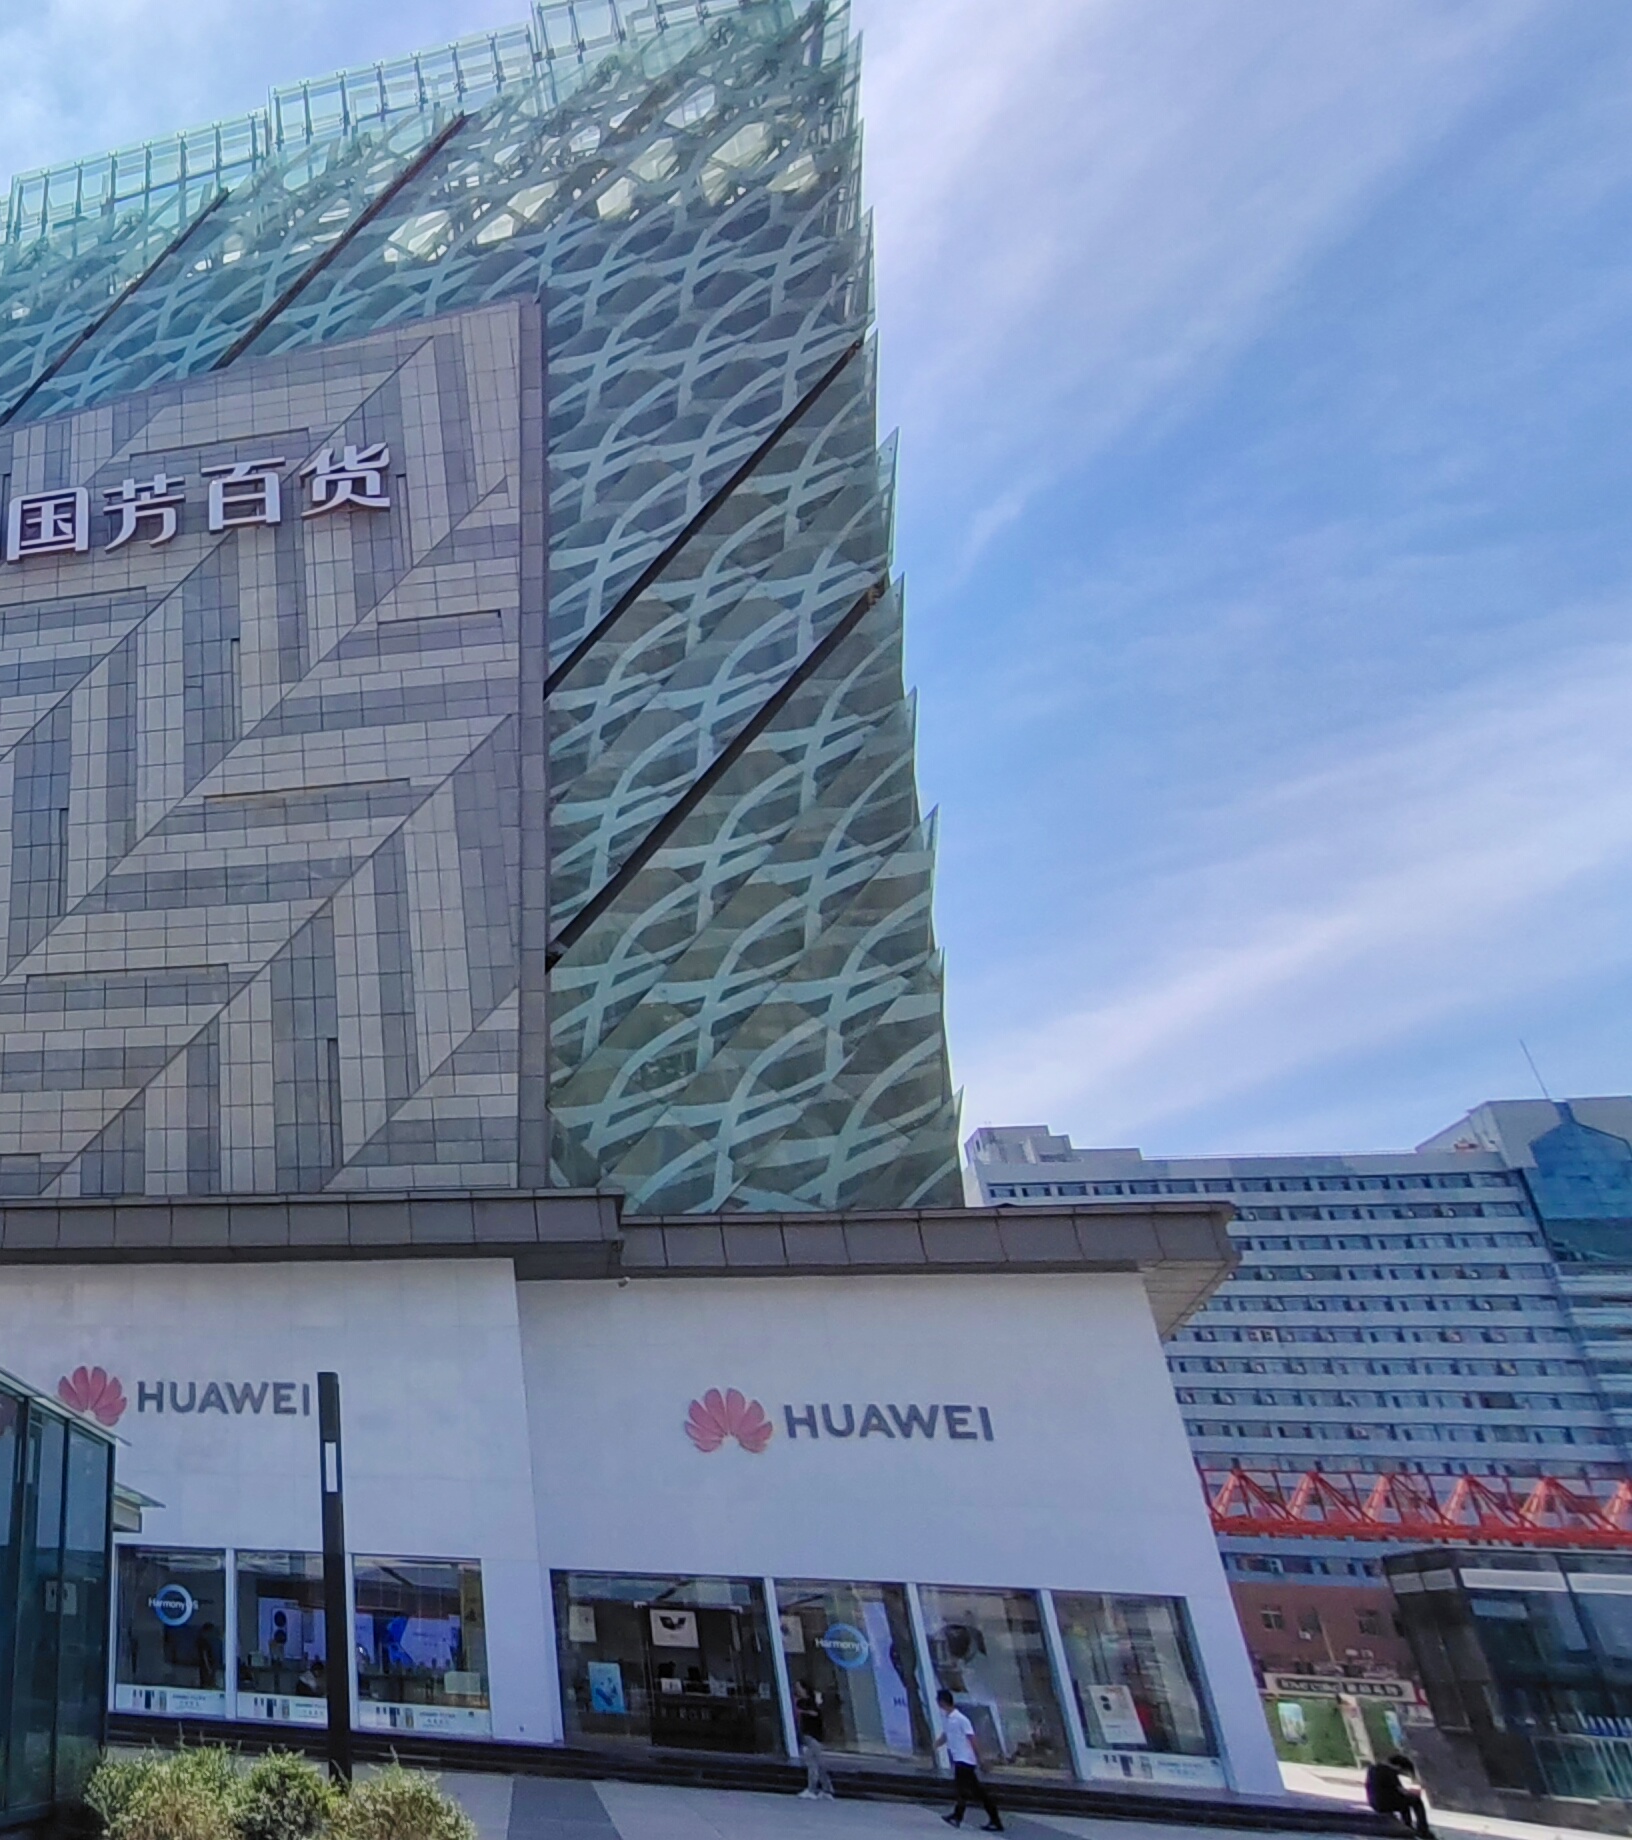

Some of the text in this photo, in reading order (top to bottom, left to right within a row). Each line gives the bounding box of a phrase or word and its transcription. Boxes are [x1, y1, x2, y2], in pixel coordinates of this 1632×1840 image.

[6, 442, 391, 562] 国芳百货
[136, 1380, 311, 1416] HUAWEI
[783, 1402, 995, 1442] HUAWEI
